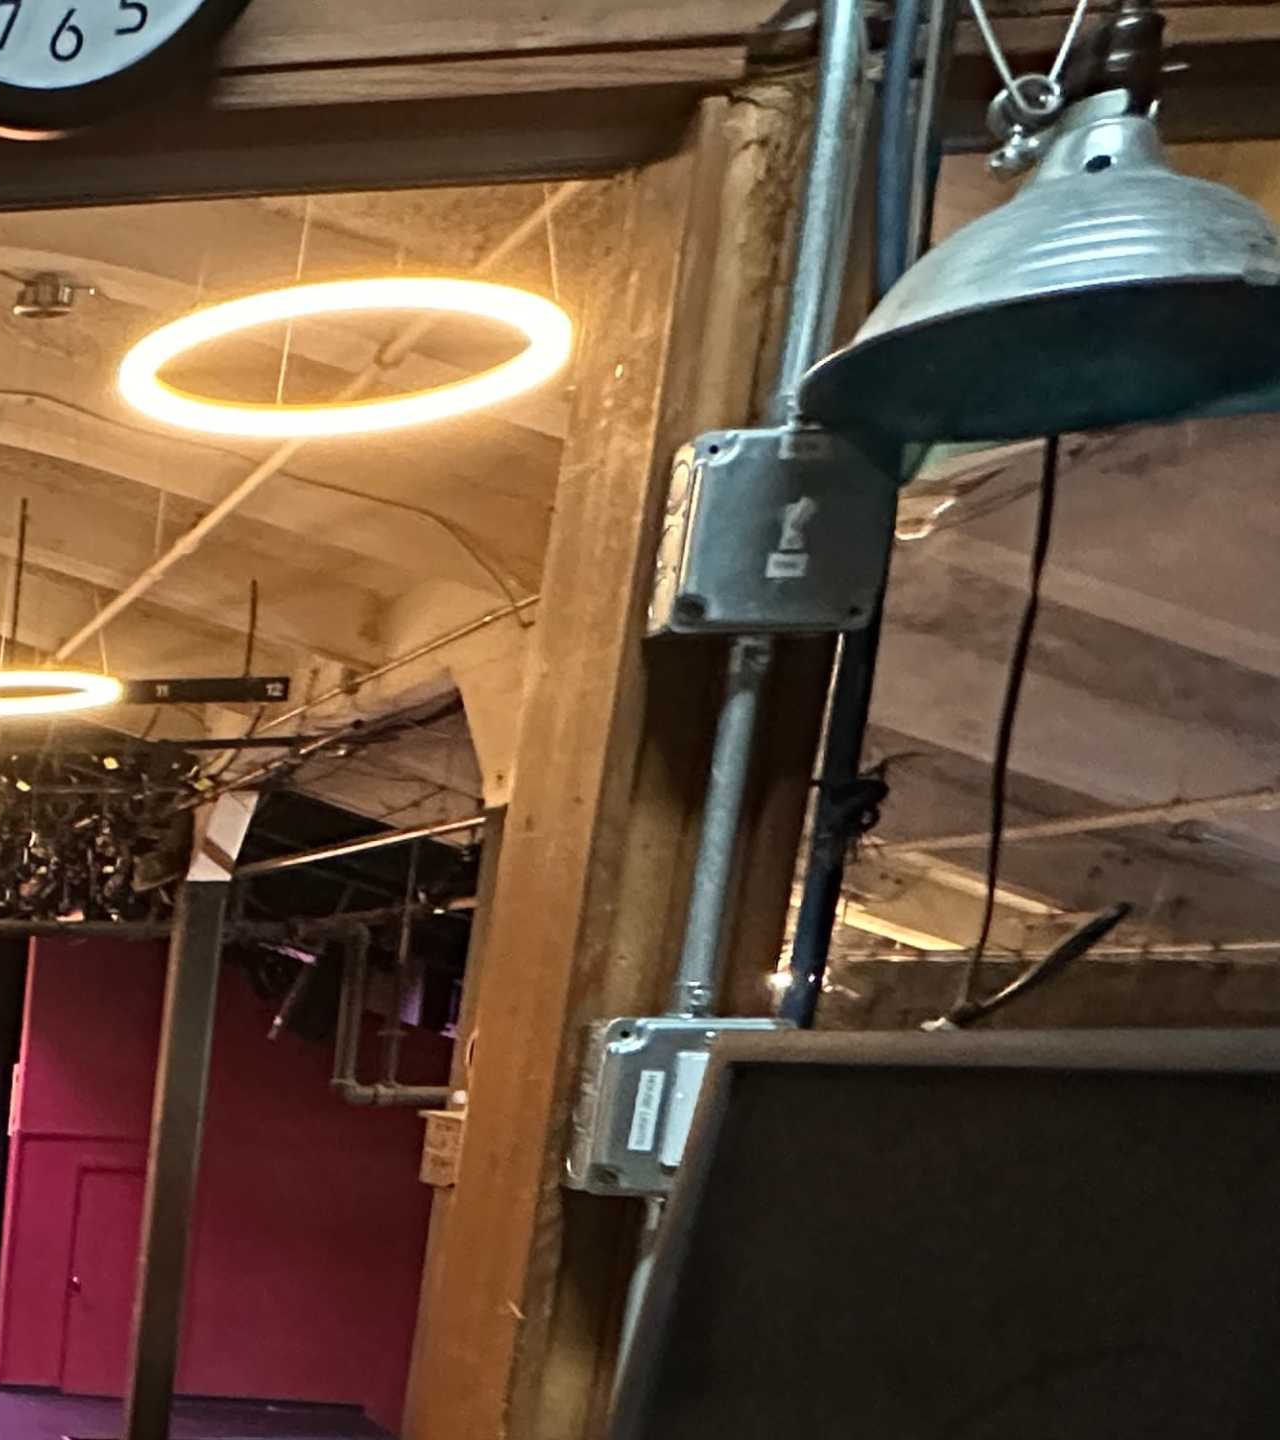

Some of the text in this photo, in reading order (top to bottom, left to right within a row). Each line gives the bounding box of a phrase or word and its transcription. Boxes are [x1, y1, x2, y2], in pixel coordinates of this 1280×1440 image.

[49, 8, 85, 62] 6
[155, 684, 169, 697] 11
[266, 683, 284, 696] 12
